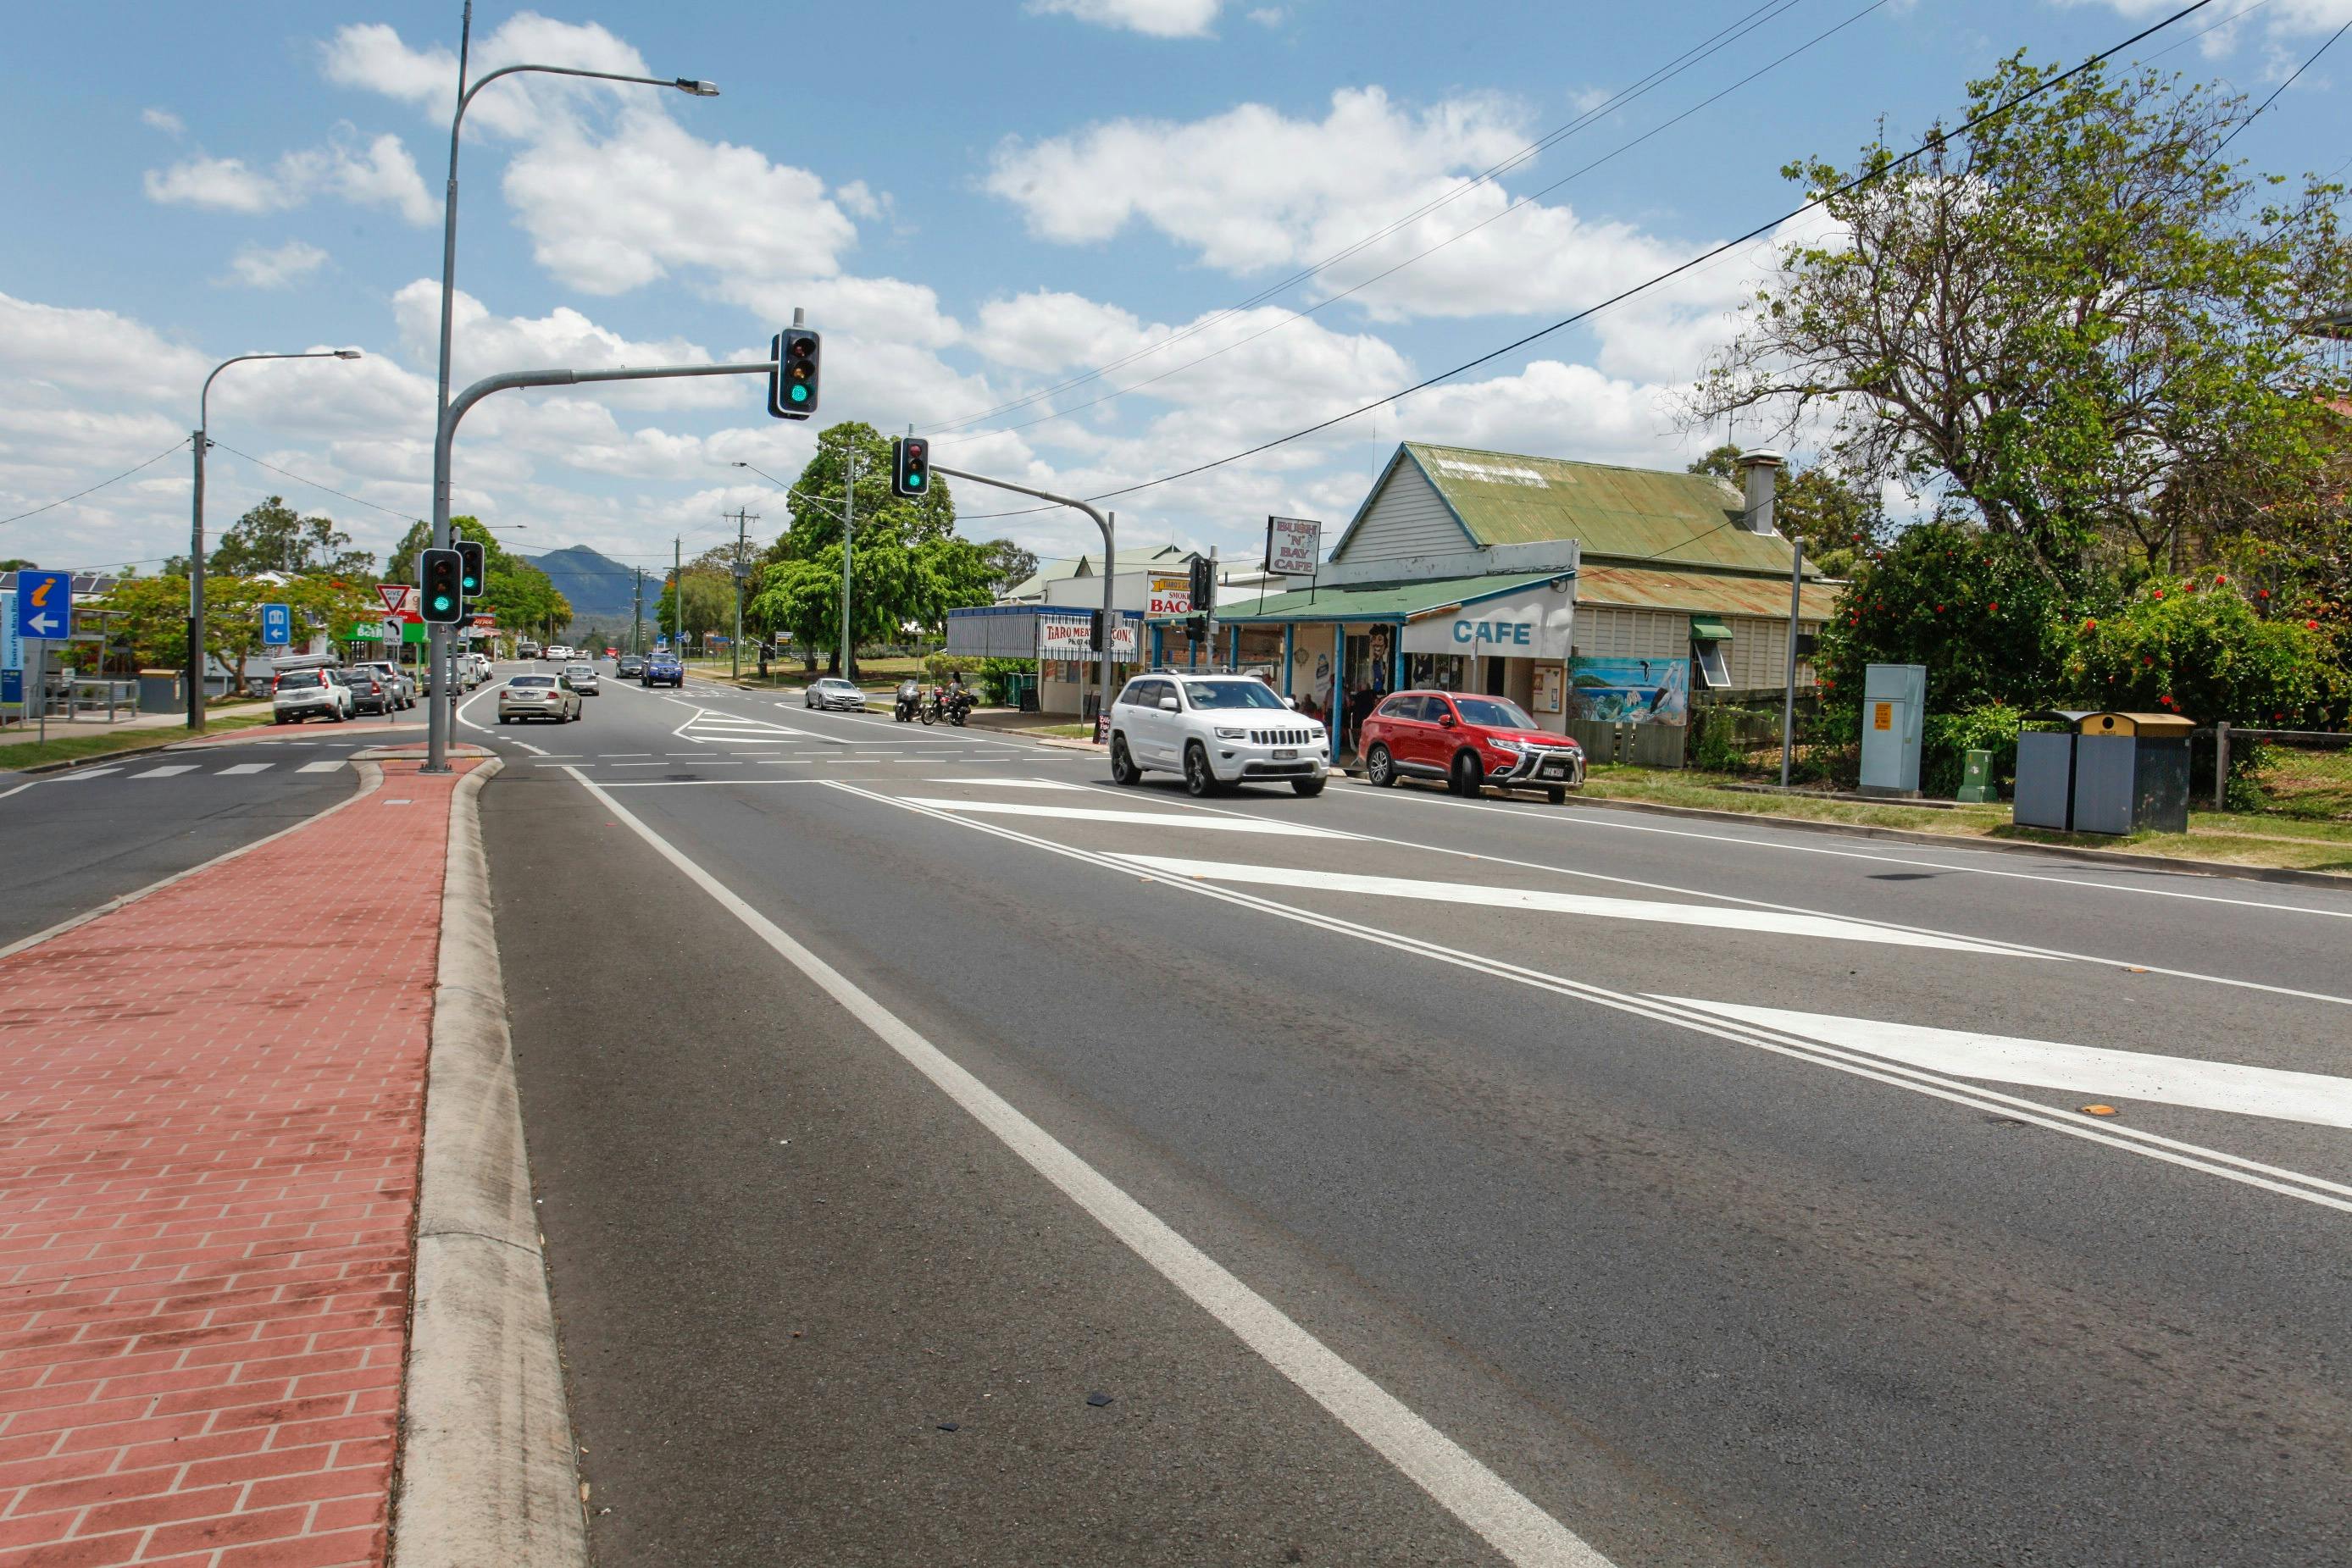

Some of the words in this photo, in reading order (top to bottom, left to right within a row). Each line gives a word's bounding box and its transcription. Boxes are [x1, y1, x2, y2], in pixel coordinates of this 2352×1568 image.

[1277, 521, 1317, 535] BUSH
[1280, 546, 1310, 559] BAY
[1273, 558, 1312, 572] CAFE
[1453, 620, 1531, 645] CAFE
